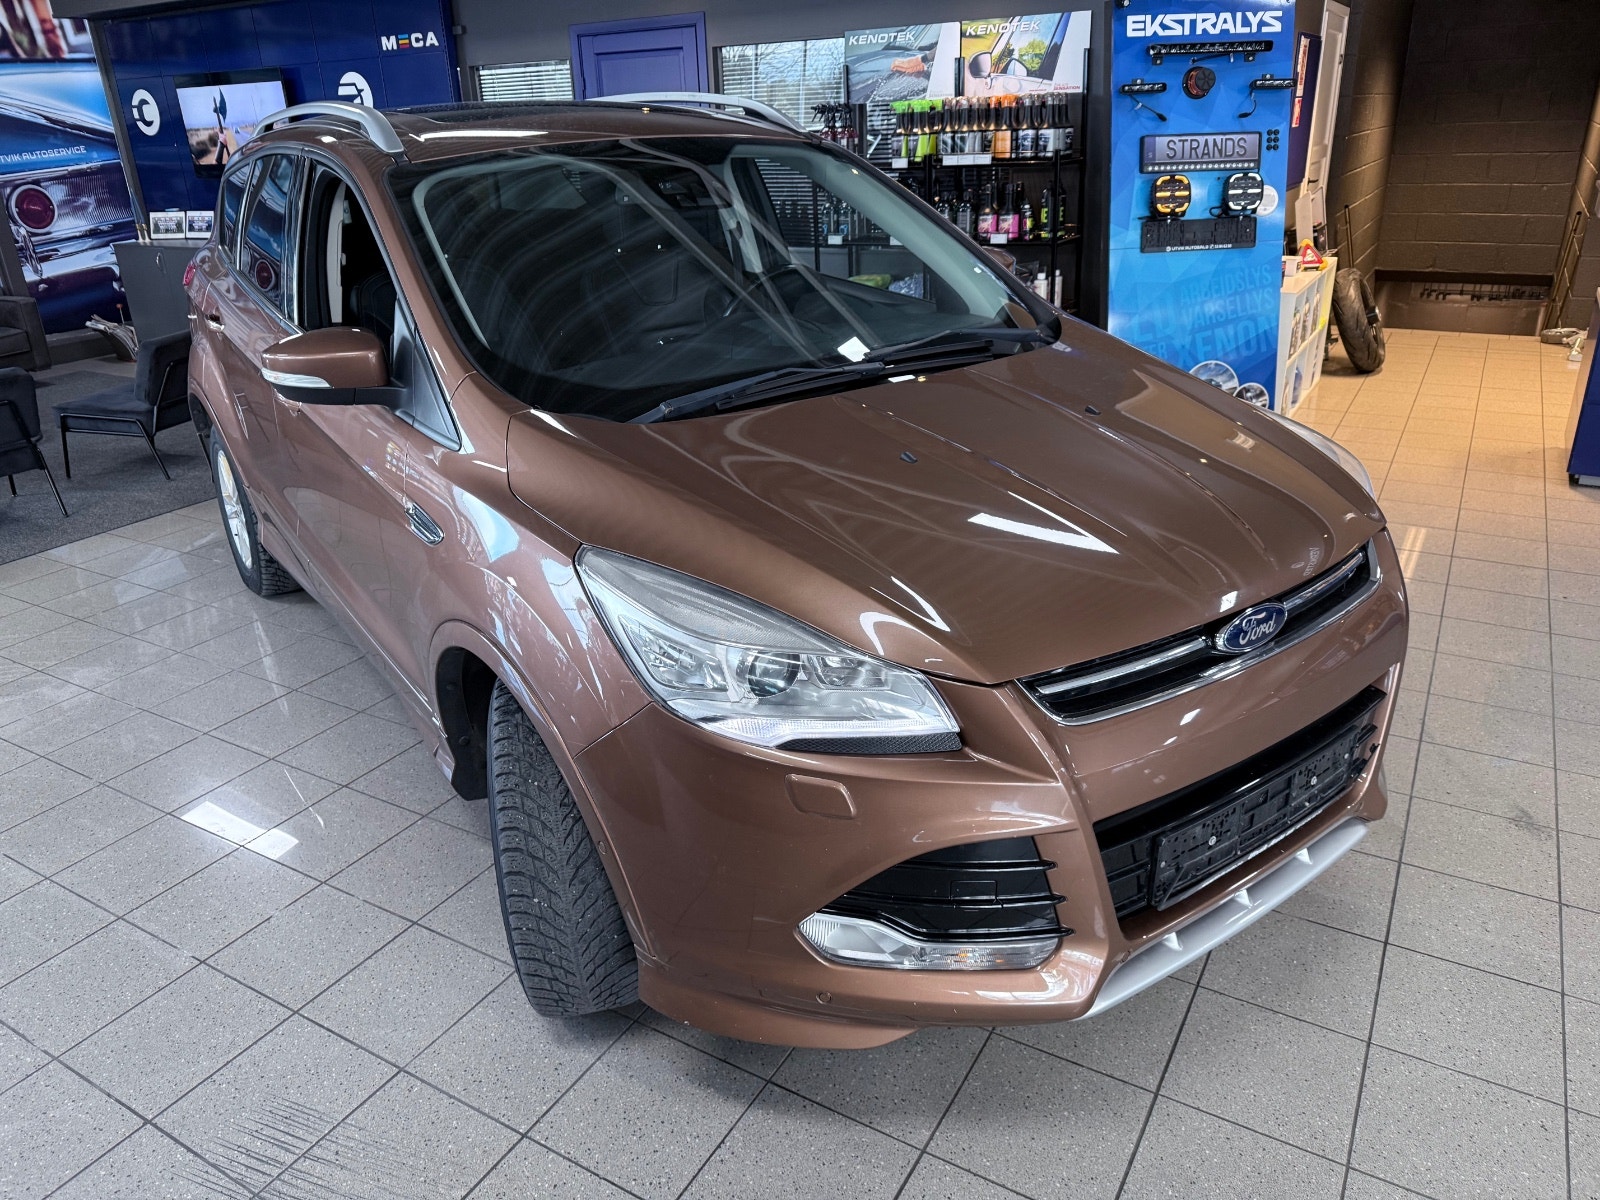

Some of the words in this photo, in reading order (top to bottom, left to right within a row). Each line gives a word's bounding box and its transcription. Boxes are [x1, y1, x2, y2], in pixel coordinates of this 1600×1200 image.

[966, 19, 1041, 37] KENOTEK
[1126, 11, 1283, 37] EKSTRALYS
[381, 31, 439, 51] MECA
[848, 30, 916, 46] KENOTEK
[22, 145, 87, 161] AUTOSERVICE
[1166, 136, 1248, 161] STRANDS
[1239, 611, 1277, 645] Ford
